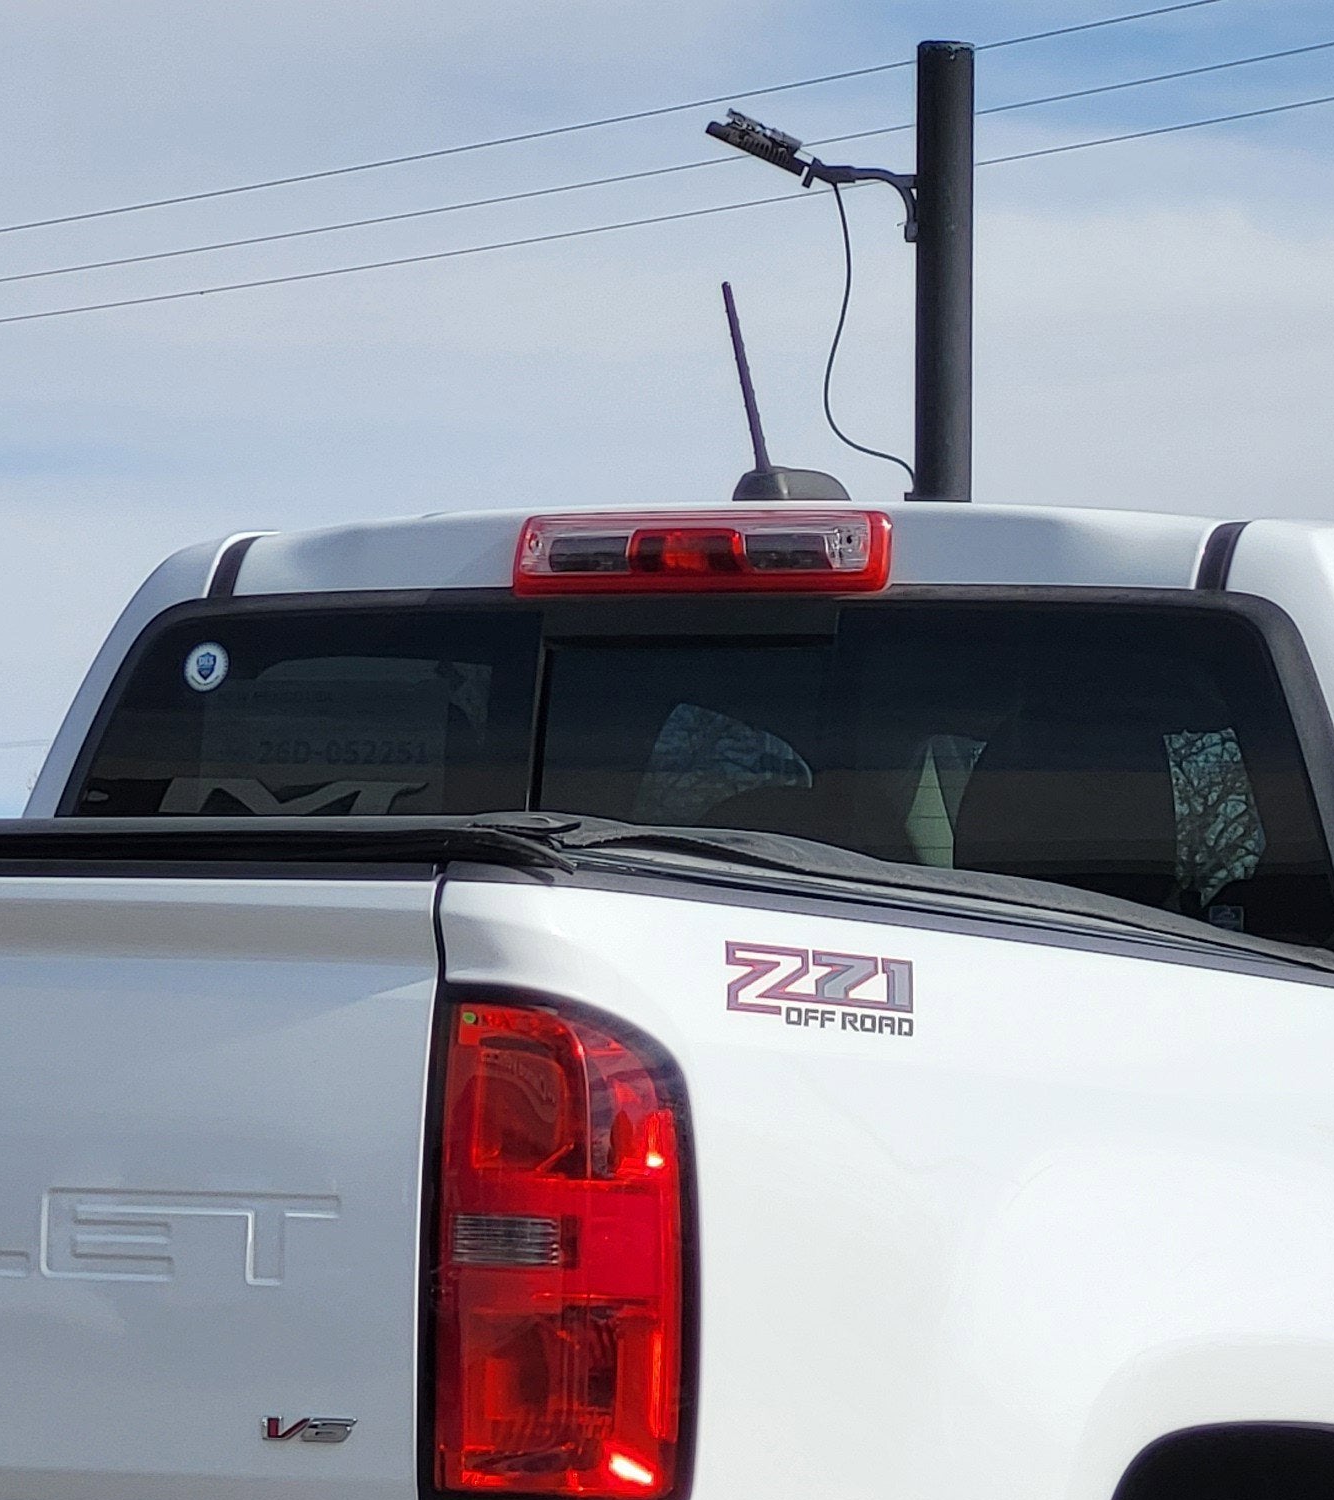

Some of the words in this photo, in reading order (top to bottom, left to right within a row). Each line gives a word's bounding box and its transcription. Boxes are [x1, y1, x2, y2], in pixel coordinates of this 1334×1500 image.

[725, 940, 914, 1014] Z71
[785, 1006, 836, 1028] OFF
[841, 1011, 914, 1037] ROAD
[261, 1415, 358, 1443] V6
